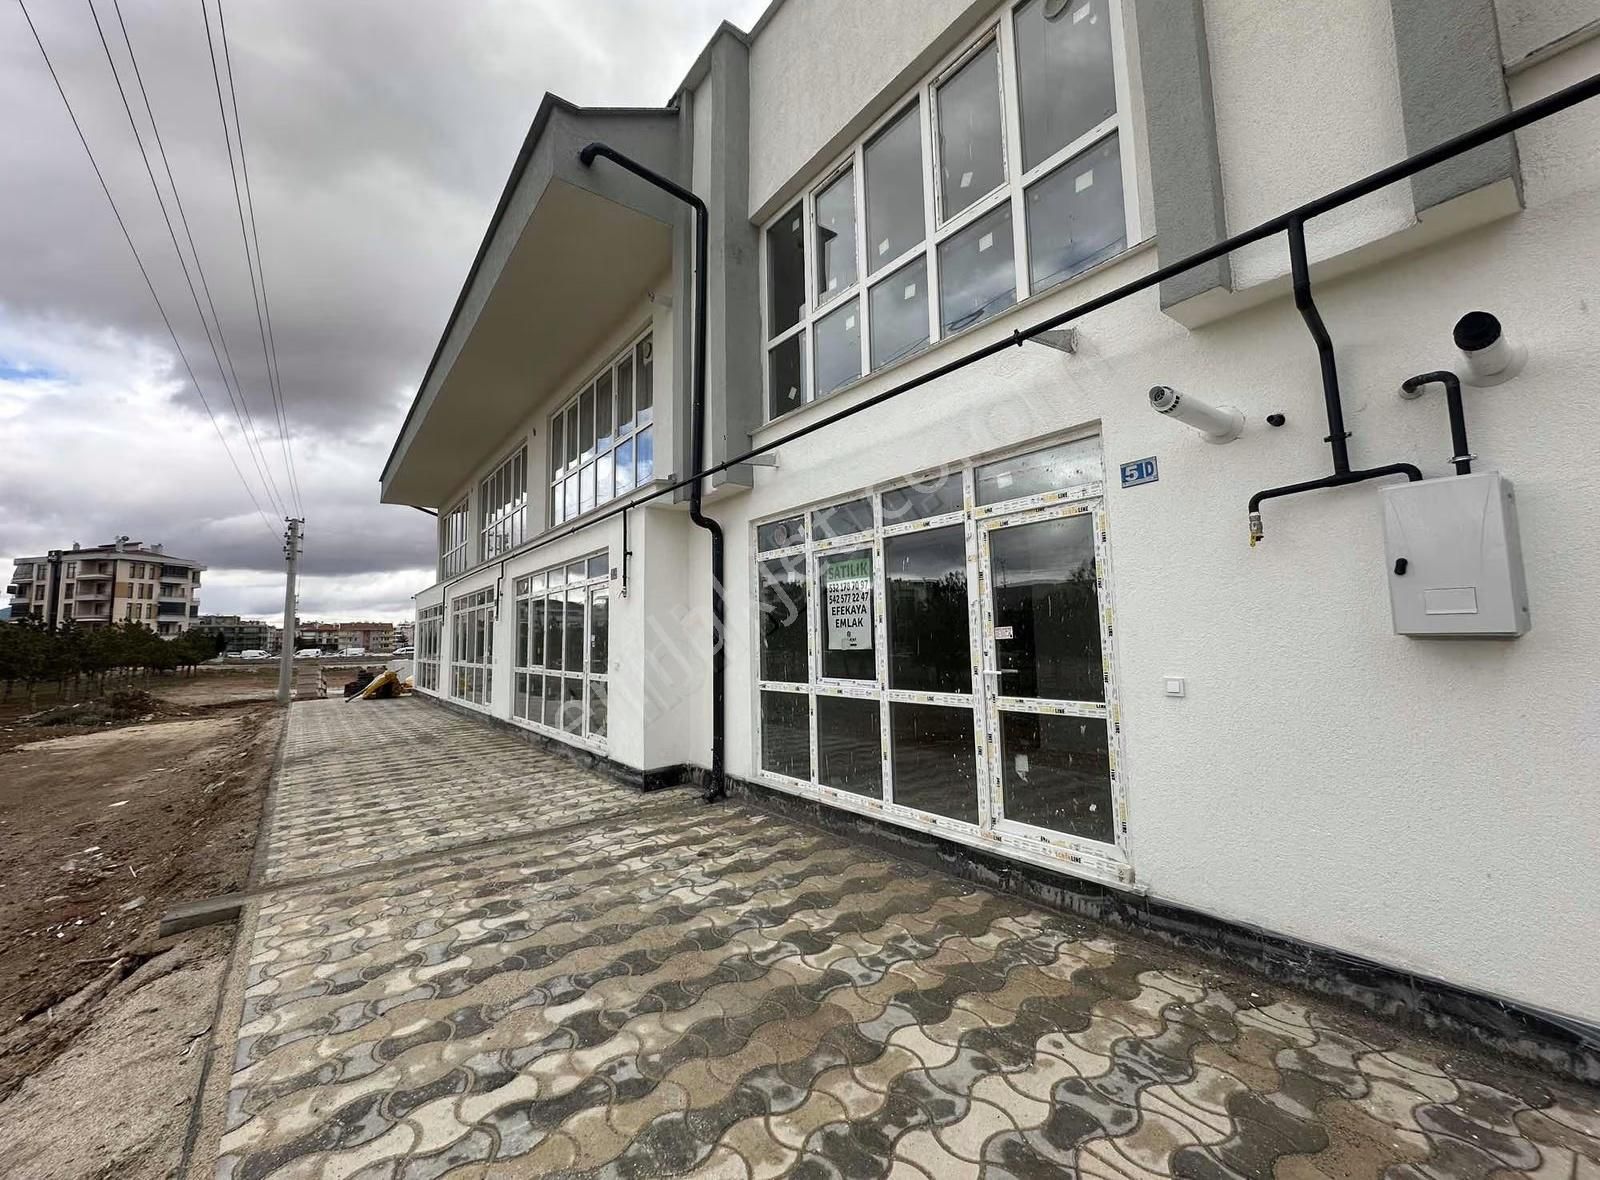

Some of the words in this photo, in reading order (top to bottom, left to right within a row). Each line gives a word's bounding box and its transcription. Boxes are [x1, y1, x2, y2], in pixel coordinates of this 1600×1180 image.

[1125, 464, 1139, 482] 5
[828, 561, 868, 580] SATILIK
[829, 594, 839, 604] 542
[840, 593, 850, 603] 577
[851, 592, 860, 602] 22
[860, 591, 869, 602] 47
[831, 604, 867, 616] EFEKAYA
[835, 617, 864, 629] EMLAK
